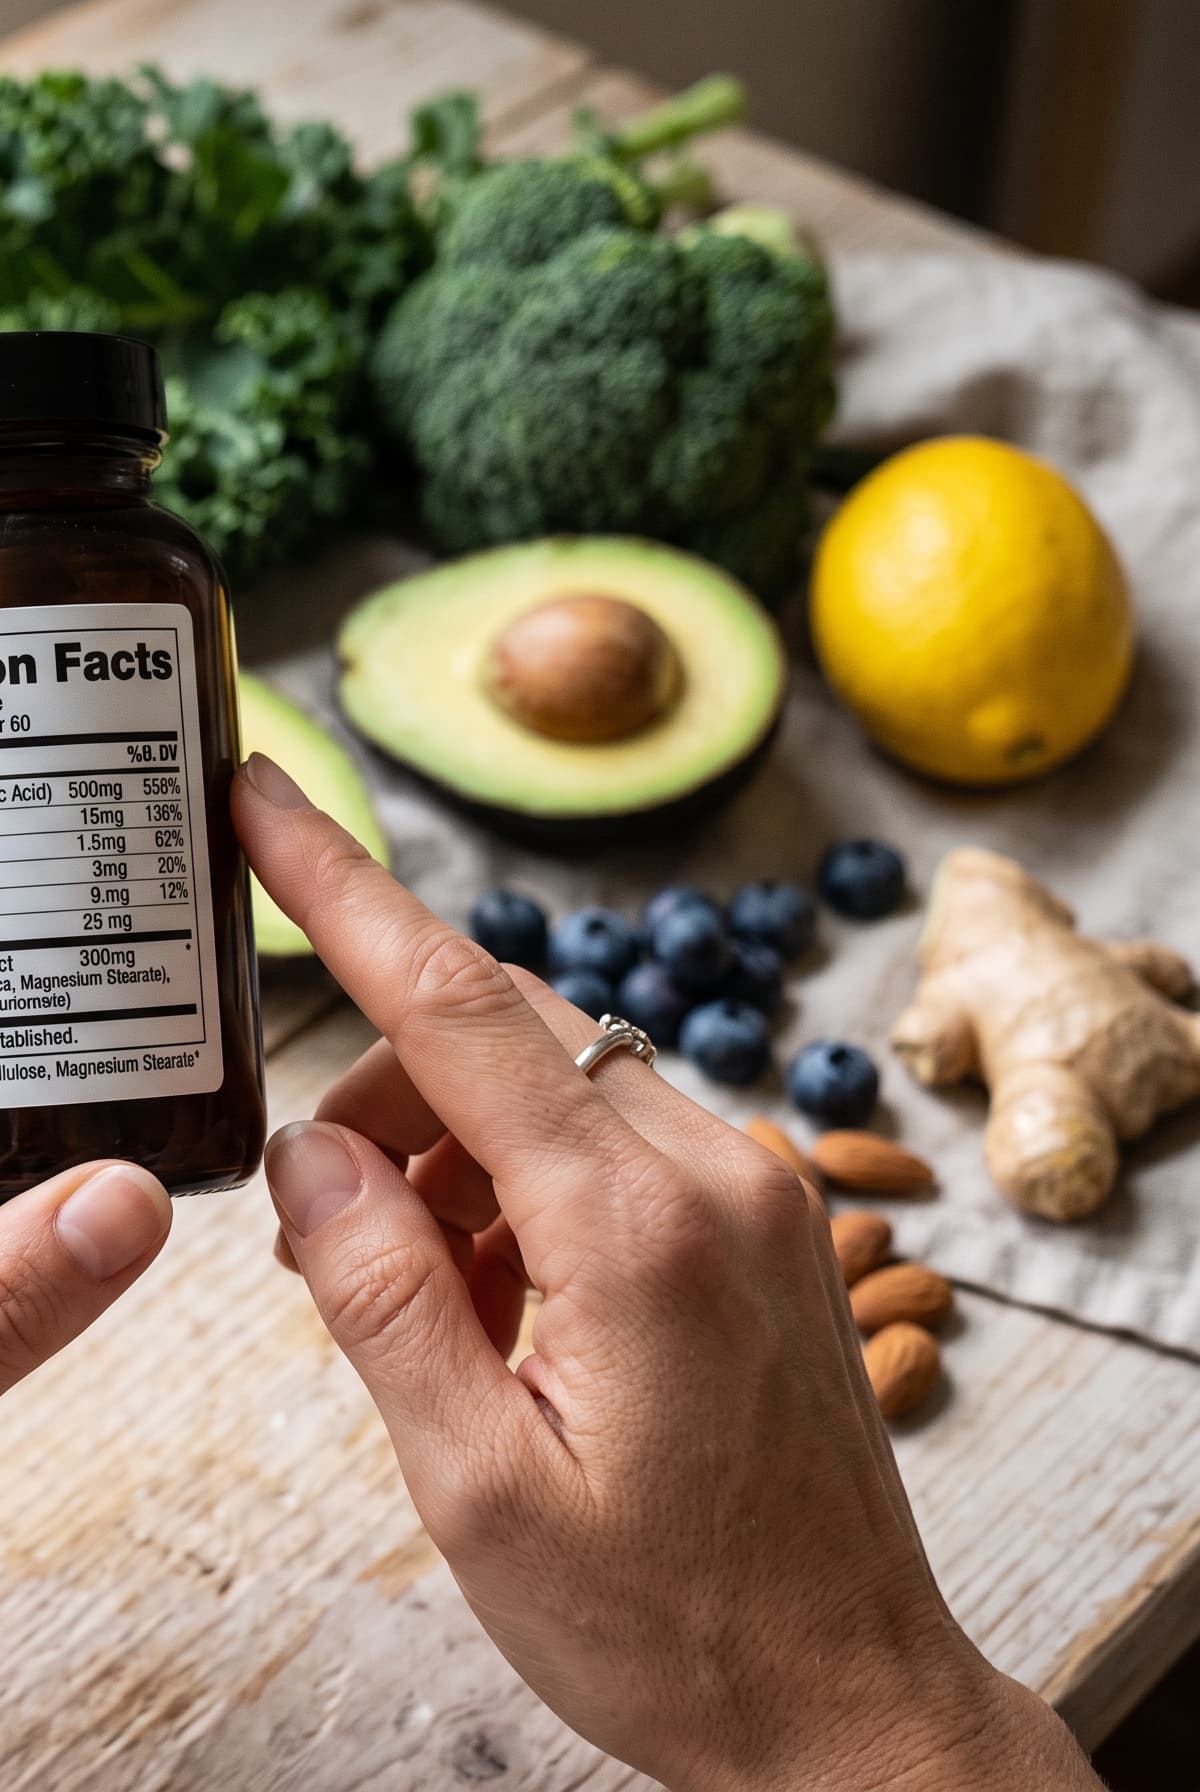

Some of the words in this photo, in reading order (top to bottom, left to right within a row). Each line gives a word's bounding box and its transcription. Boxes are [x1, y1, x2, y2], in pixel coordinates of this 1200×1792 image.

[54, 642, 173, 682] Facts
[10, 715, 30, 732] 60
[160, 744, 177, 761] DV
[12, 782, 52, 804] Acid)
[69, 781, 122, 800] 500mg
[80, 808, 124, 826] 15mg
[146, 805, 183, 821] 136%
[77, 834, 126, 853] 1.5mg
[155, 831, 184, 847] 62%
[93, 860, 127, 879] 3mg
[158, 857, 186, 873] 20%
[90, 886, 130, 905] 9.mg
[160, 882, 188, 899] 12%
[83, 915, 103, 930] 25
[108, 914, 132, 931] mg
[80, 949, 135, 967] 300mg
[21, 973, 102, 992] Magnesium
[56, 1057, 138, 1078] Magnesium
